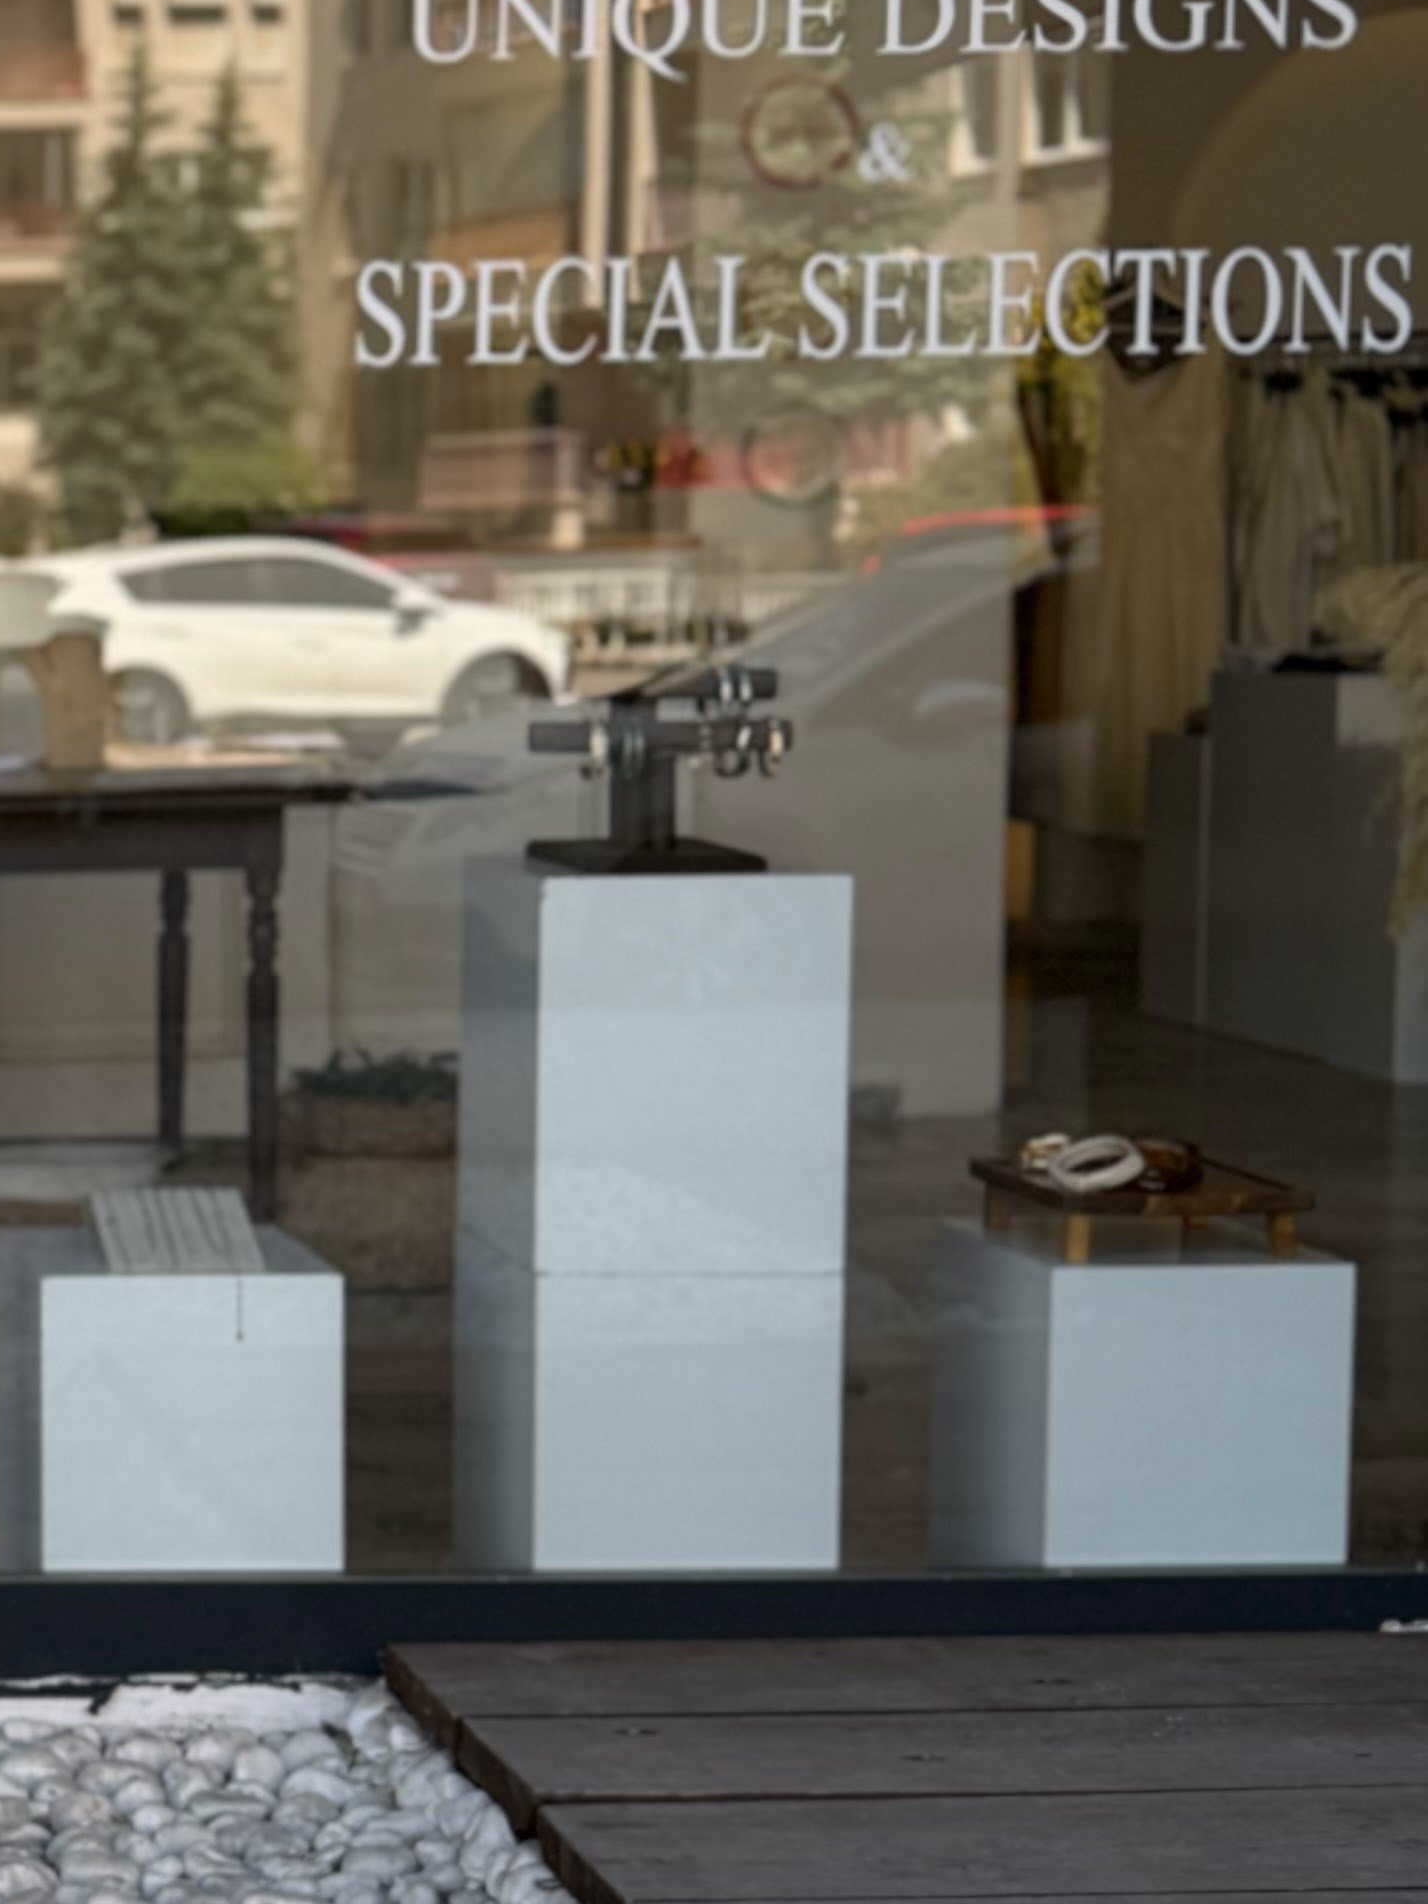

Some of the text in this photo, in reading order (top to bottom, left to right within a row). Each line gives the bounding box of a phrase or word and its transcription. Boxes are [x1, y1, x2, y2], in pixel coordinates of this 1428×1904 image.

[857, 121, 913, 184] &
[352, 243, 1413, 368] SPECIAL SELECTIONS
